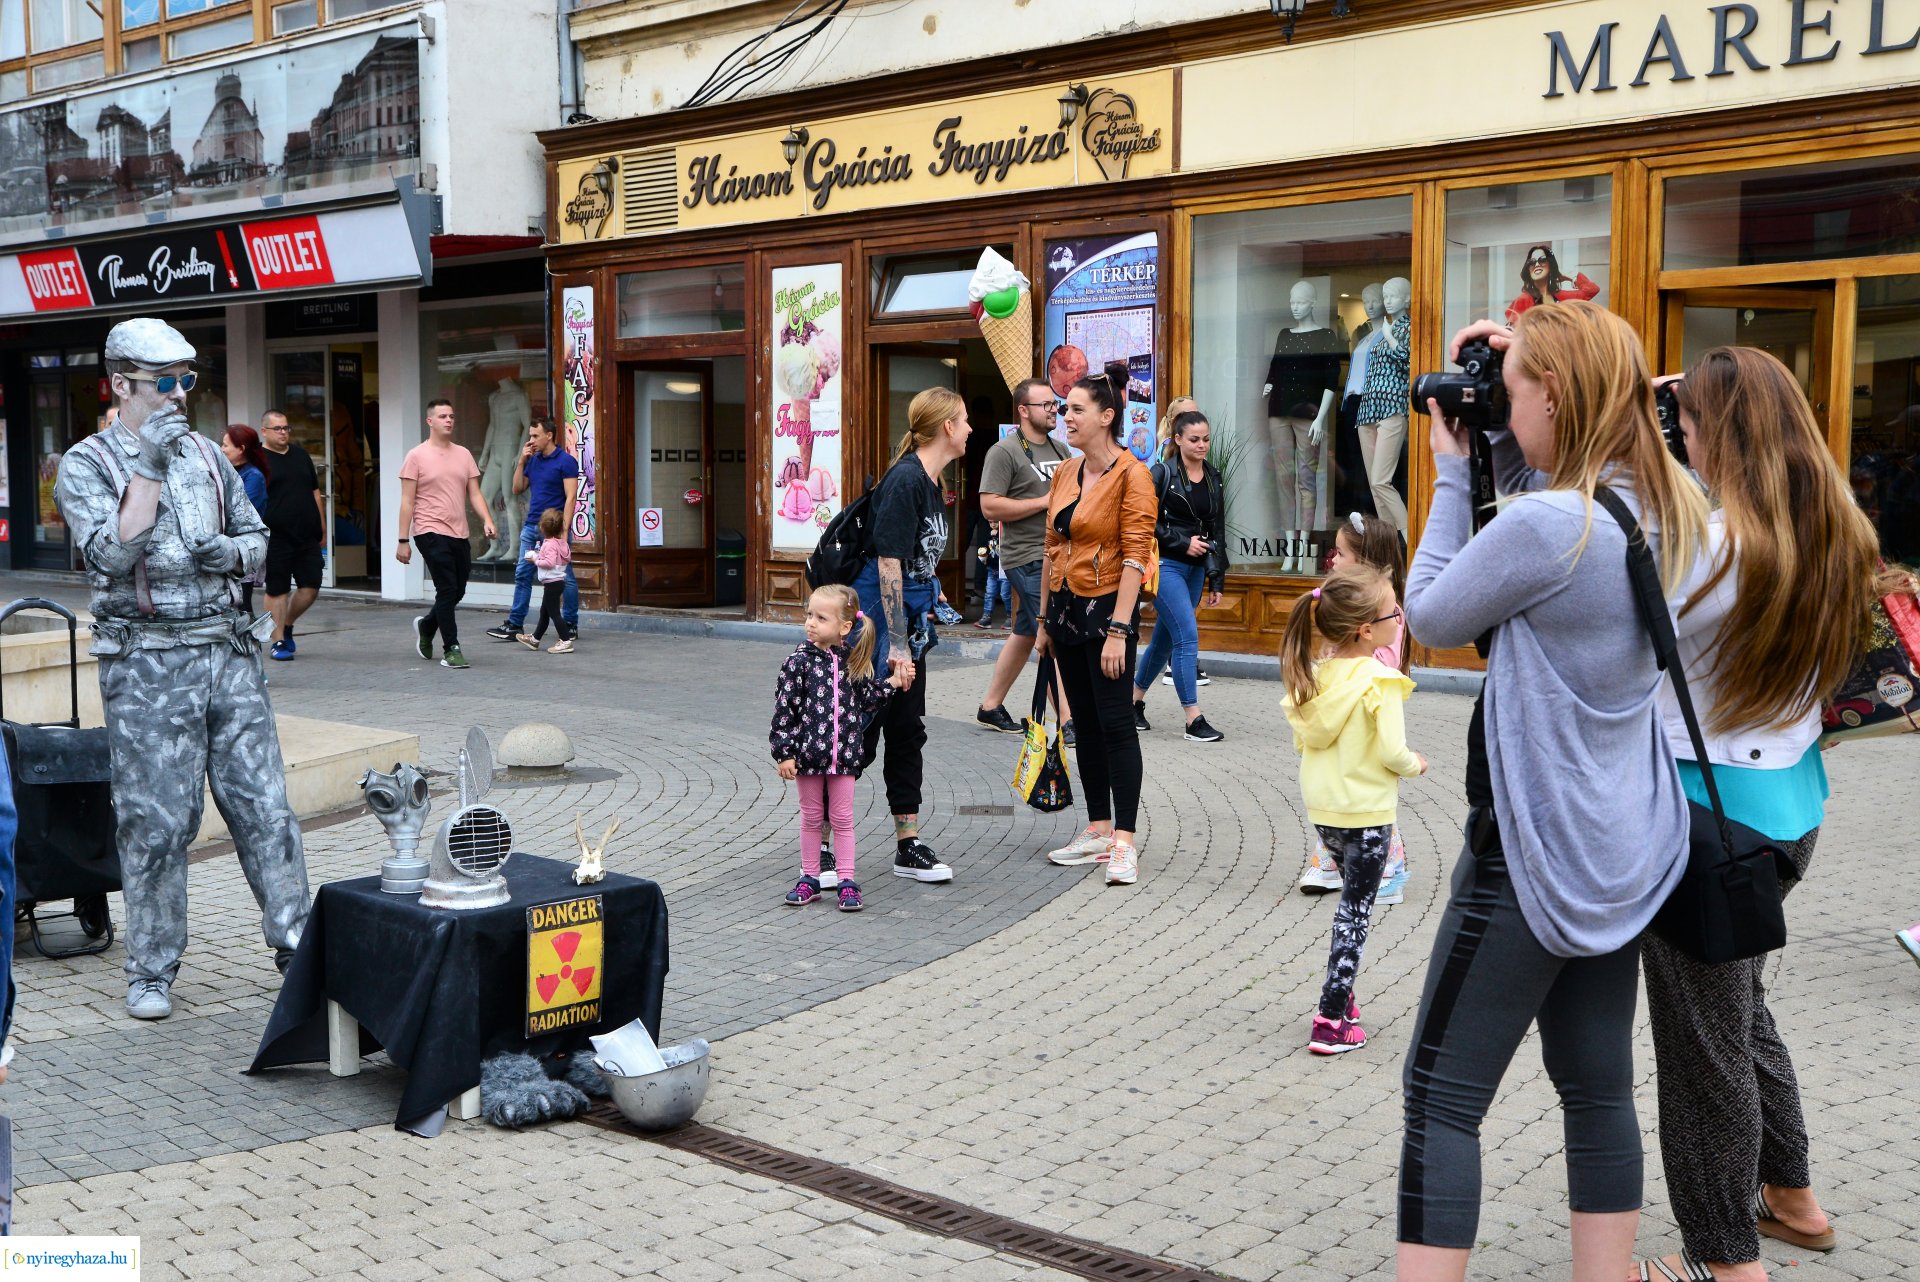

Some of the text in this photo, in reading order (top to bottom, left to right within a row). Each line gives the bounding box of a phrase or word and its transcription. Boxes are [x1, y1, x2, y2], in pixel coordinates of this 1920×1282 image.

[1104, 110, 1132, 123] Három
[1107, 121, 1140, 141] Grácia
[1091, 128, 1158, 161] Fagyizó
[683, 115, 1070, 210] Három Grácia Fagyizó
[565, 201, 607, 228] Fagyizó
[26, 230, 323, 299] OUTLET Thomas Breitling OUTLET
[1089, 260, 1156, 285] TÉRKÉP
[303, 302, 350, 315] BREITLING
[775, 281, 816, 314] Három
[788, 291, 840, 337] Grácia
[571, 332, 591, 538] FAGYIZÓ
[1480, 474, 1491, 499] EOS
[1880, 683, 1912, 697] Mobiloil
[532, 898, 599, 929] DANGER
[529, 1002, 599, 1033] RADIATION
